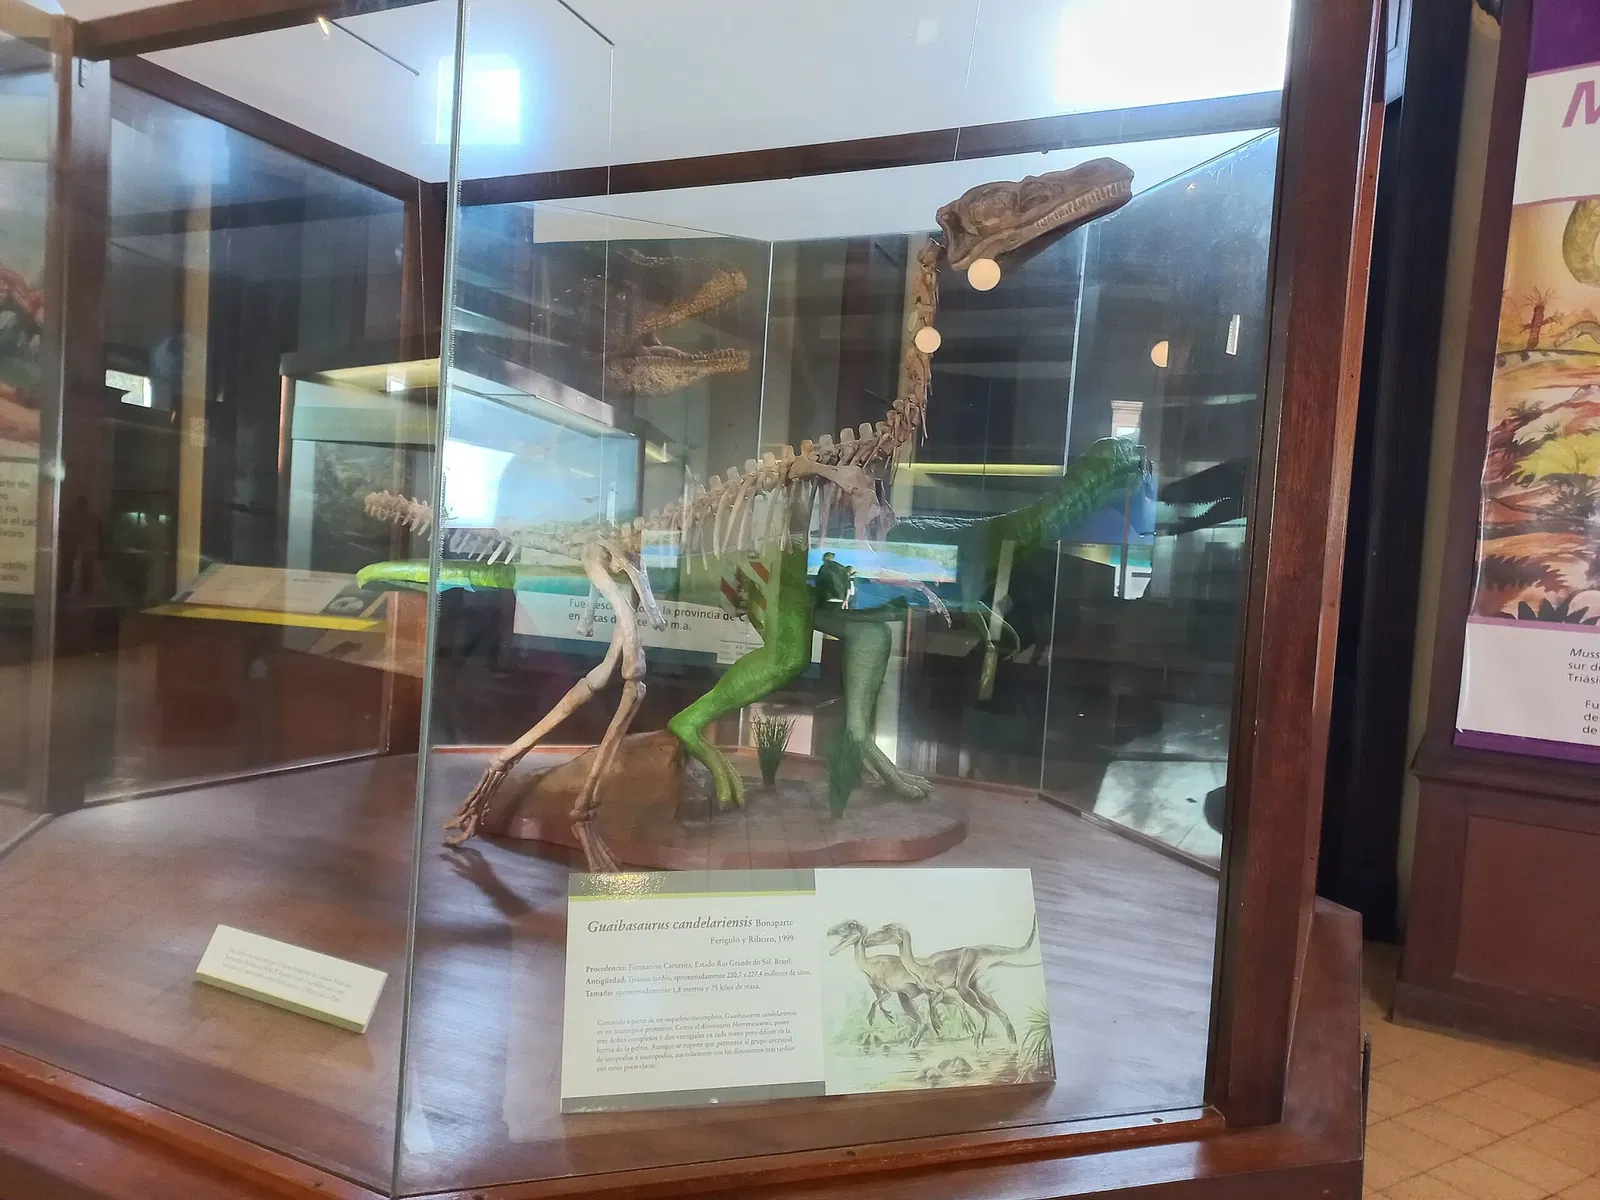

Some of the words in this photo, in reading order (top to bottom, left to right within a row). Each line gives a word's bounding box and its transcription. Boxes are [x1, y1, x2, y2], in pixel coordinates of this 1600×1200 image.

[662, 605, 672, 615] la
[674, 608, 720, 620] provincia
[568, 612, 580, 621] en
[670, 621, 692, 631] m.a.
[1568, 662, 1586, 670] sur
[1583, 712, 1599, 722] de
[1582, 725, 1598, 735] de
[587, 919, 670, 933] Guaibasaurus
[672, 915, 753, 930] candelariensis
[755, 918, 795, 929] Bonaparte
[710, 935, 740, 947] Ferigolo
[742, 938, 747, 946] y
[748, 934, 777, 944] Ribeiro,
[778, 933, 794, 943] 1999
[585, 964, 627, 973] Procedencia:
[628, 962, 662, 972] Formación
[694, 959, 716, 968] Estado
[728, 958, 752, 967] Grande
[752, 957, 761, 966] do
[585, 976, 626, 986] Antigüedad:
[673, 970, 726, 983] aproximadamente
[726, 970, 742, 980] 220,7
[747, 970, 763, 979] 227,4
[788, 968, 796, 976] de
[585, 988, 614, 998] Tamaño:
[672, 985, 682, 994] 1,8
[710, 984, 718, 992] 75
[719, 983, 734, 992] kilos
[735, 982, 743, 991] de
[674, 1023, 694, 1032] Como
[713, 1030, 727, 1038] cada
[785, 1026, 790, 1034] la
[651, 1043, 675, 1052] Aunque
[623, 1062, 639, 1072] poco
